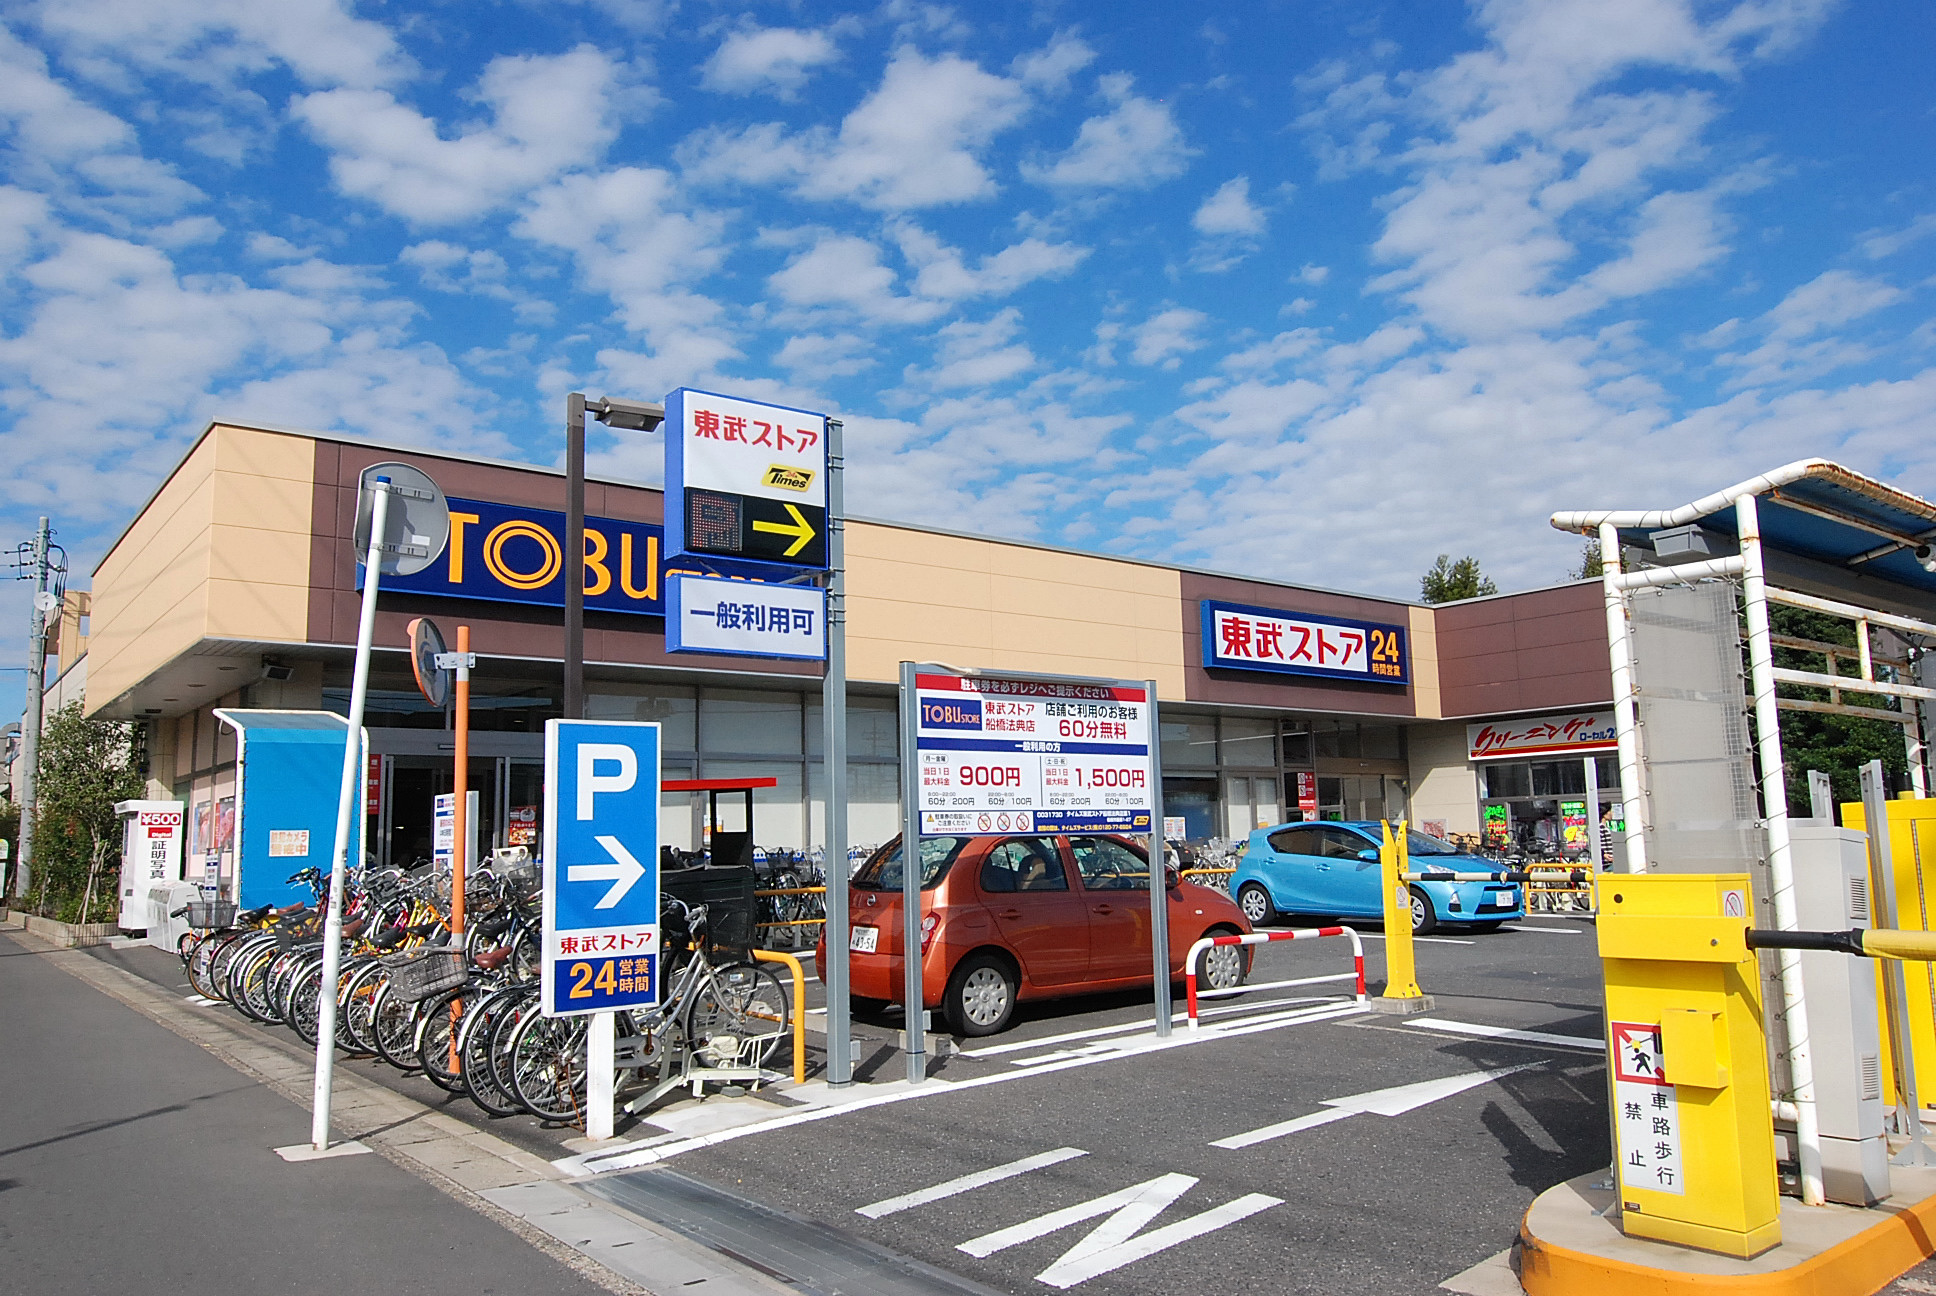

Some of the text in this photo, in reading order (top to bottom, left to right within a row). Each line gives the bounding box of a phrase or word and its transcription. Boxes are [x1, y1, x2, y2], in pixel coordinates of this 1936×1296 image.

[694, 409, 818, 453] 東武ストア
[770, 472, 807, 488] Times
[448, 511, 658, 601] TOBU
[690, 602, 815, 635] 一般利用可
[1222, 617, 1363, 665] 東武ストア
[1371, 630, 1399, 662] 24
[1371, 663, 1401, 677] 時間営業
[960, 678, 1109, 698] 駐車券を必ずレジへご提示ください
[923, 704, 980, 724] TOBU STORE
[985, 701, 1035, 716] 東武ストア
[1045, 702, 1138, 720] 店舗ご利用のお客様
[985, 718, 1035, 732] 船橋法典店
[1059, 719, 1127, 739] 60分無料
[1580, 727, 1618, 741] ローヤル2
[1014, 741, 1061, 752] 一般利用の方
[1475, 717, 1597, 757] クリーニング
[577, 743, 638, 820] P
[924, 767, 950, 776] 当日1日
[924, 777, 950, 786] 最大料金
[960, 766, 1021, 787] 900円
[1075, 768, 1145, 789] 1,500円
[1045, 778, 1069, 786] 最大料金
[141, 813, 180, 825] ¥500
[149, 840, 168, 880] 証明写真
[560, 932, 652, 955] 東武ストア
[619, 957, 649, 976] 営業
[569, 960, 618, 999] 24
[619, 976, 649, 994] 時間
[1624, 1101, 1647, 1168] 禁止
[1651, 1091, 1675, 1186] 車路歩行
